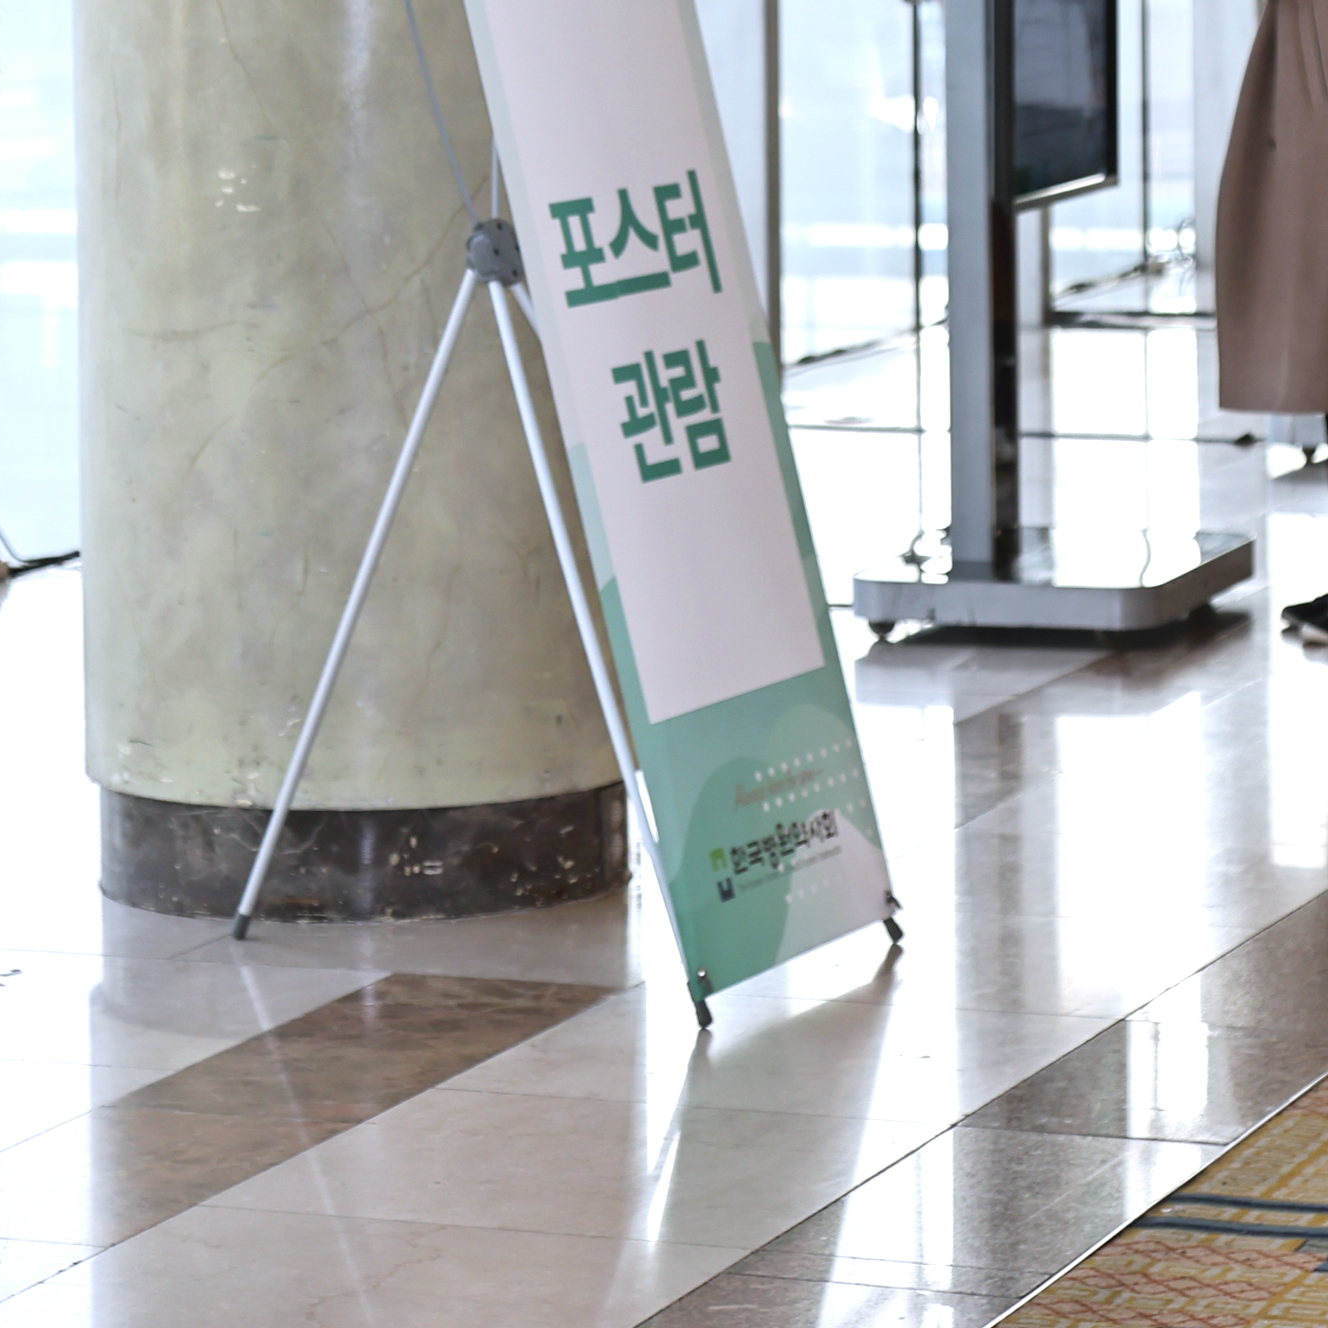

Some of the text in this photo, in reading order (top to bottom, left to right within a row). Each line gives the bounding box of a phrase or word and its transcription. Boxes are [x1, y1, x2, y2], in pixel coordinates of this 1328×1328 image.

[548, 168, 723, 308] 포스터
[611, 338, 732, 483] 관람
[729, 811, 839, 876] 한국병원약사회
